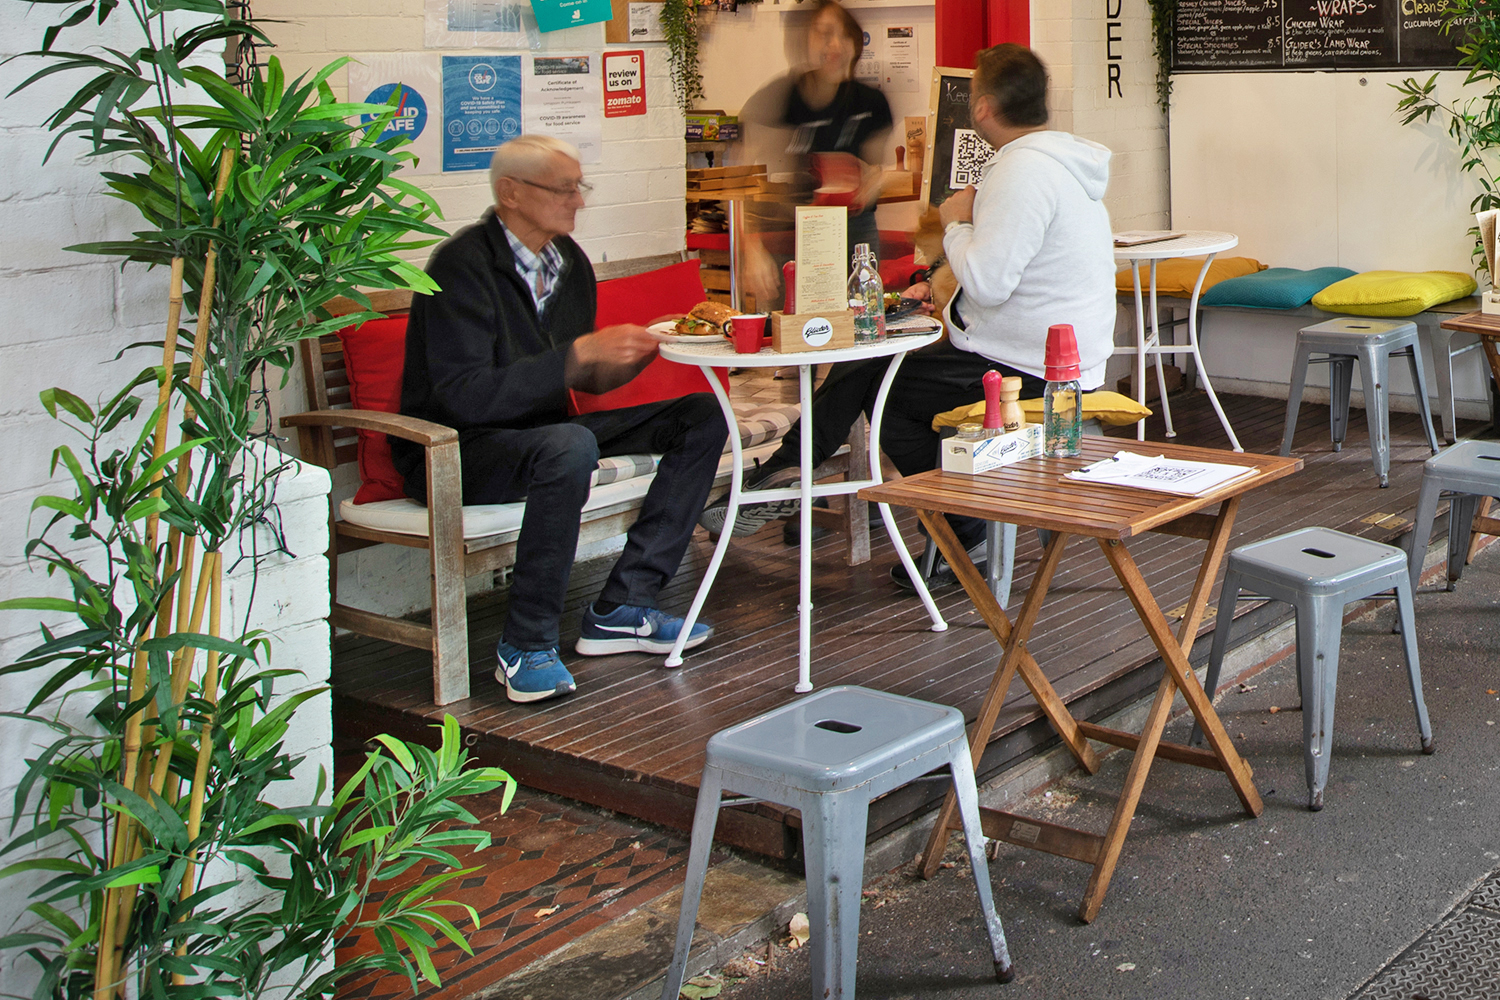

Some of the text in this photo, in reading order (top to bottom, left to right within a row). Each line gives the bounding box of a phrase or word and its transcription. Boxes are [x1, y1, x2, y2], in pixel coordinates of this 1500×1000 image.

[1317, 0, 1367, 16] WRAPS
[1285, 18, 1317, 29] CHICKEN
[1319, 16, 1344, 29] WRAP
[1403, 19, 1442, 29] cucumber
[1324, 37, 1370, 49] LAMB WRAP
[609, 69, 637, 78] review
[608, 95, 642, 106] zomato
